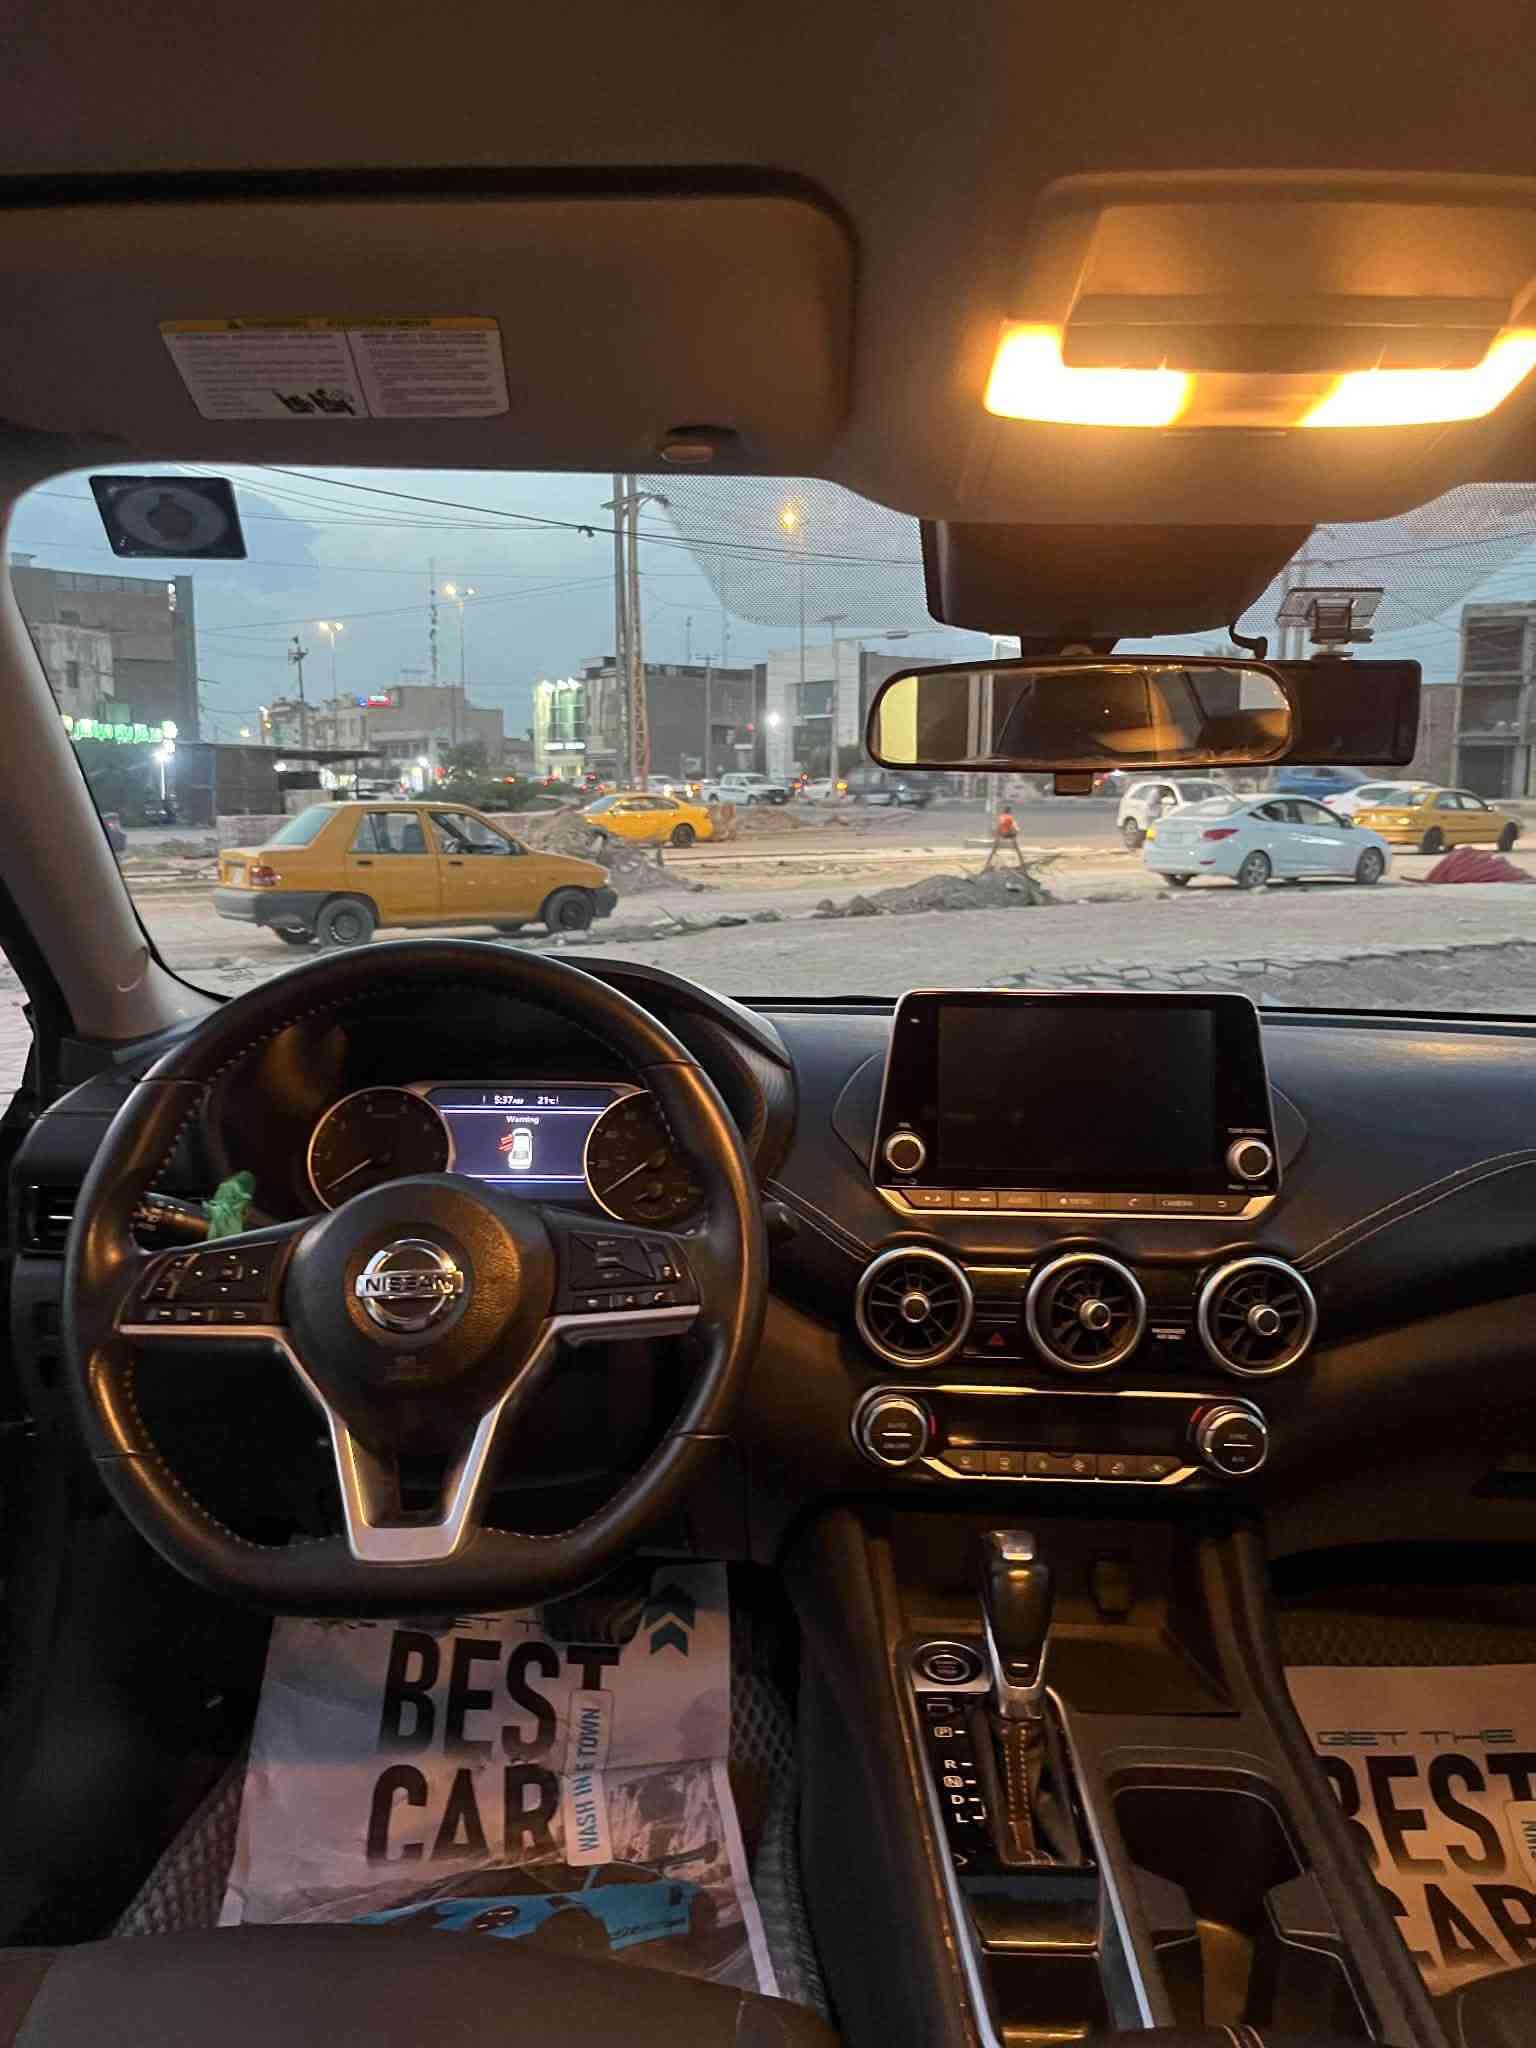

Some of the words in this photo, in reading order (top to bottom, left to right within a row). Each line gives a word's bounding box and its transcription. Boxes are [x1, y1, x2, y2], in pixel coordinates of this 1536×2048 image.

[505, 1115, 540, 1125] Warning
[365, 1277, 456, 1293] NISSAN
[576, 1708, 601, 1757] TOWN
[1316, 1730, 1408, 1746] GET
[1418, 1728, 1517, 1745] THE
[944, 1759, 958, 1769] R
[951, 1794, 965, 1805] D
[366, 1764, 561, 1868] CAR
[576, 1800, 601, 1853] WASH
[1376, 1882, 1536, 1970] AR
